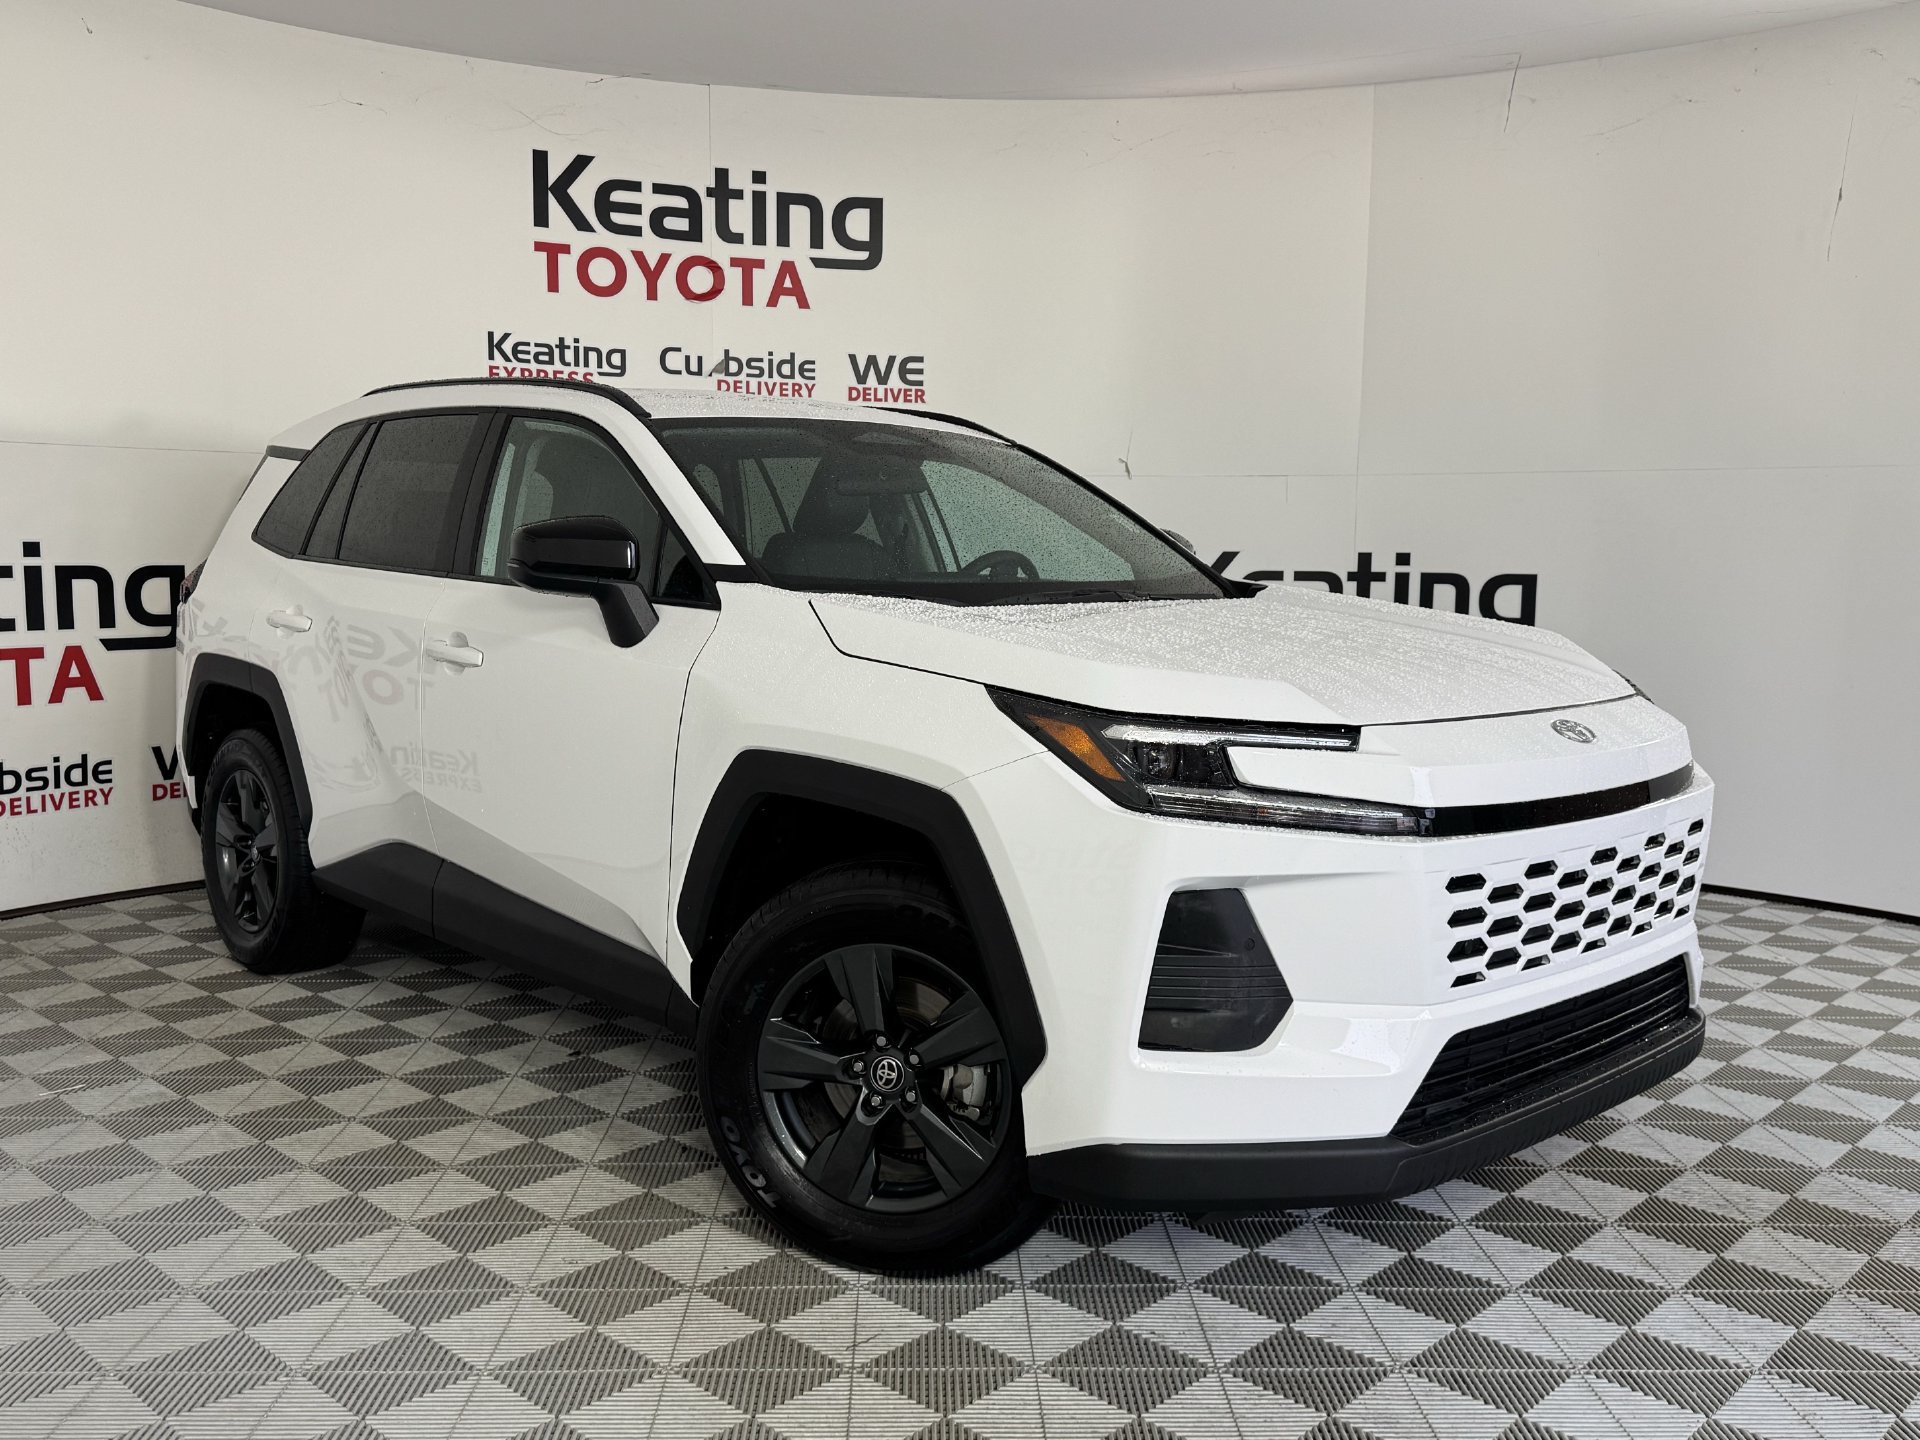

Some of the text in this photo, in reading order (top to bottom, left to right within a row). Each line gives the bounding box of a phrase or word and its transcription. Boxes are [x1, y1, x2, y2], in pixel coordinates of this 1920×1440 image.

[532, 148, 884, 271] Keating
[533, 241, 811, 310] TOYOTA
[487, 330, 627, 378] Keating
[659, 346, 816, 380] Cubside
[847, 353, 925, 387] WE
[716, 379, 816, 398] DELIVERY
[847, 386, 926, 404] DELIVER
